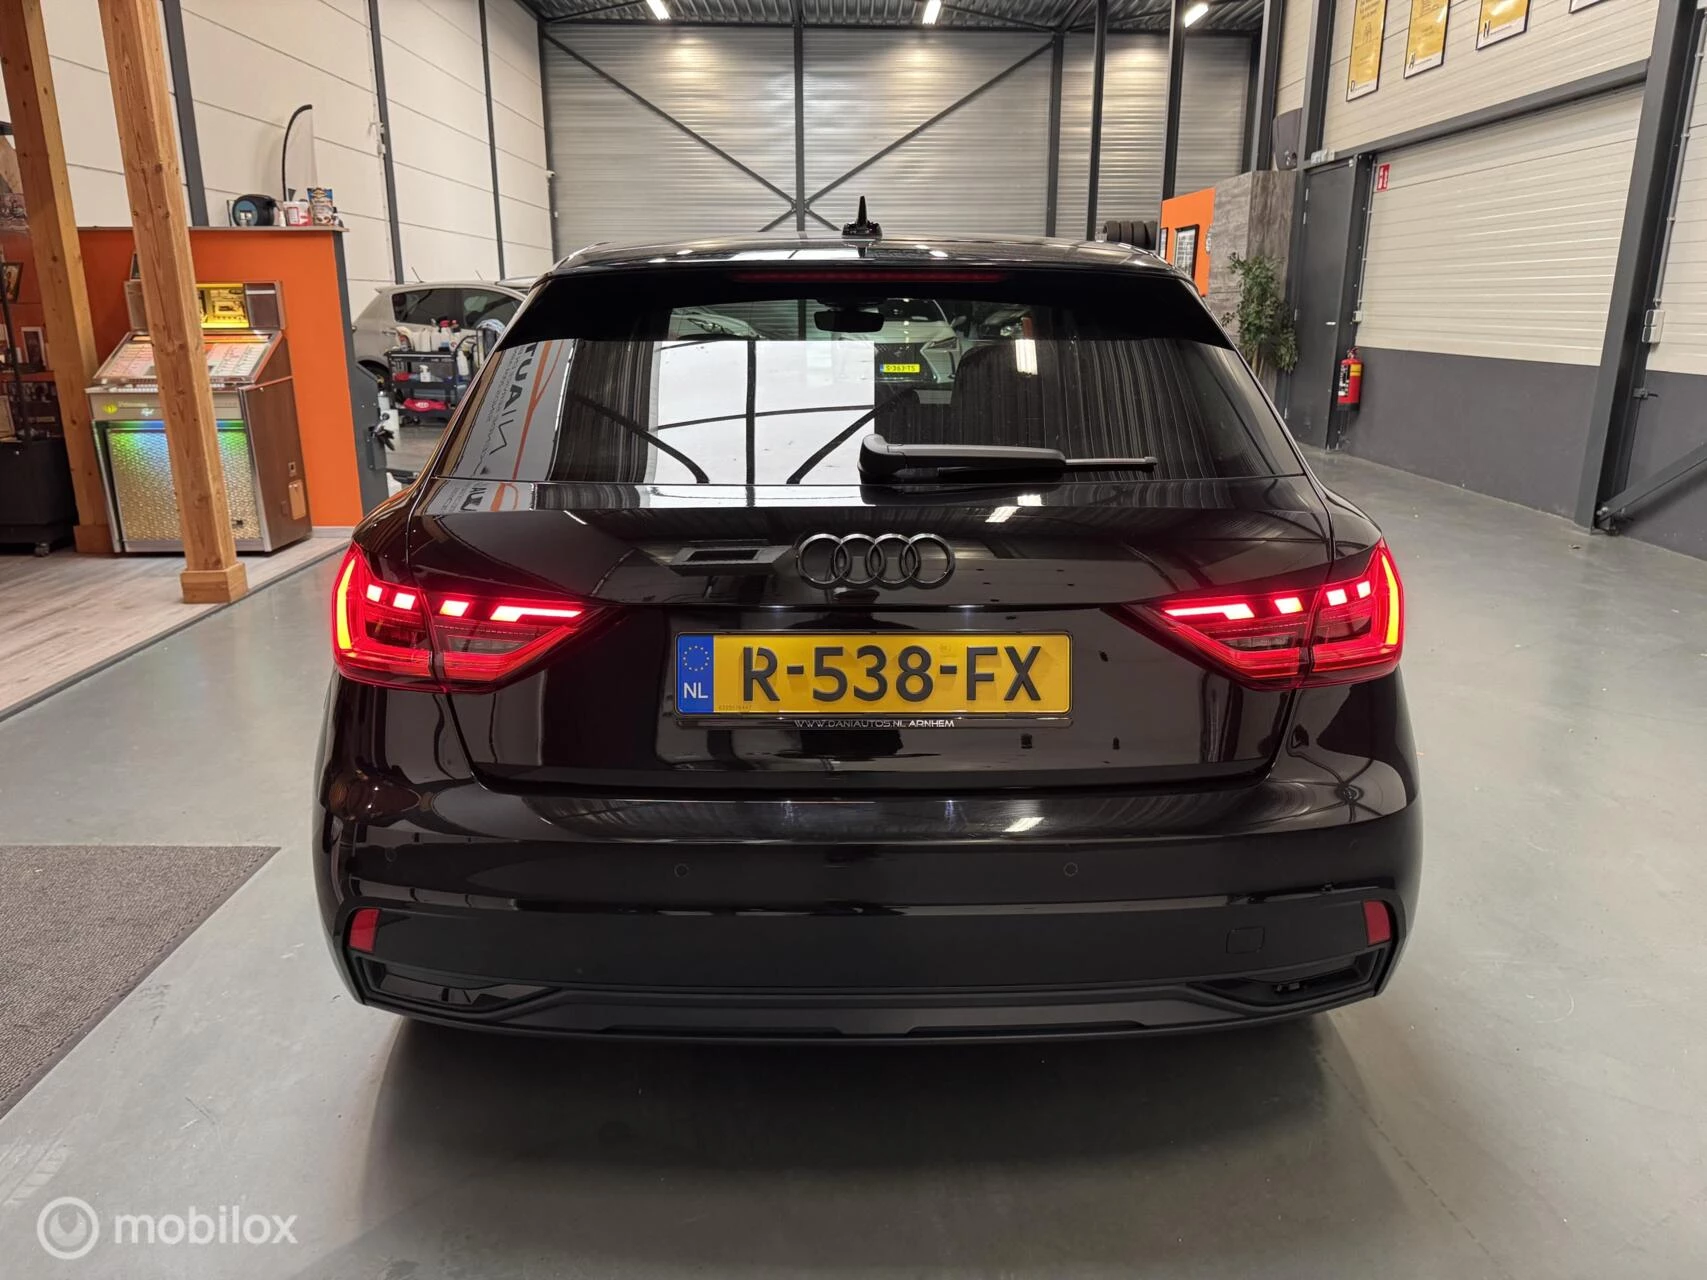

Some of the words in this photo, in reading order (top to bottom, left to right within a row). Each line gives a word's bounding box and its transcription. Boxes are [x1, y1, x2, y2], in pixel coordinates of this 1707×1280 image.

[742, 645, 1042, 702] R-538-FX
[683, 682, 709, 699] NL
[794, 719, 906, 728] WWW.DANIAUTOS.NL
[909, 719, 955, 728] ARNHEM
